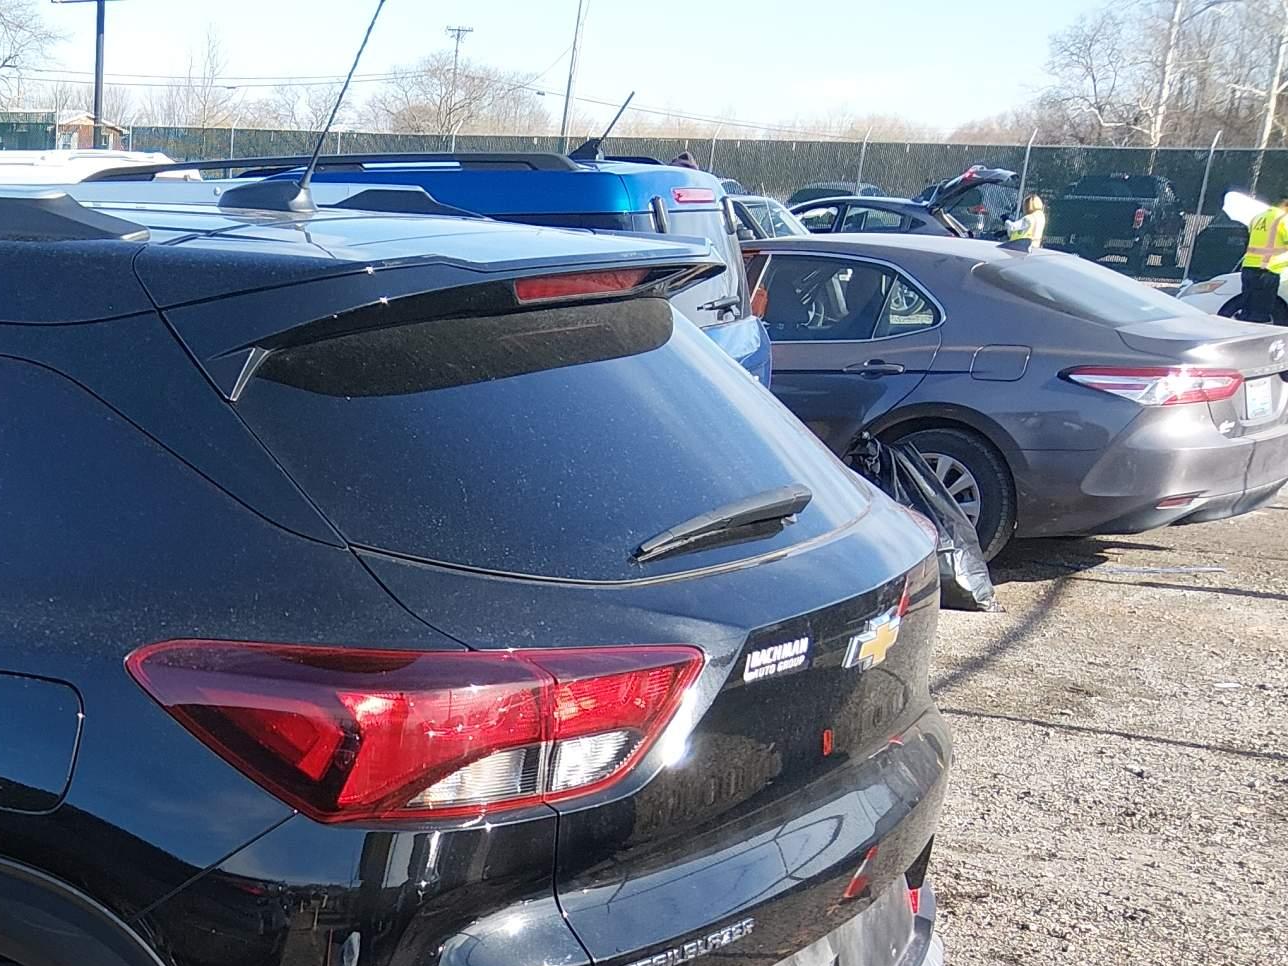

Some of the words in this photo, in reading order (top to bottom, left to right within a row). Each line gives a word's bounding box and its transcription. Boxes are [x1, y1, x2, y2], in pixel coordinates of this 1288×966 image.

[749, 637, 809, 669] BACHMAN
[751, 662, 776, 680] AUTO
[776, 654, 806, 672] GROUP
